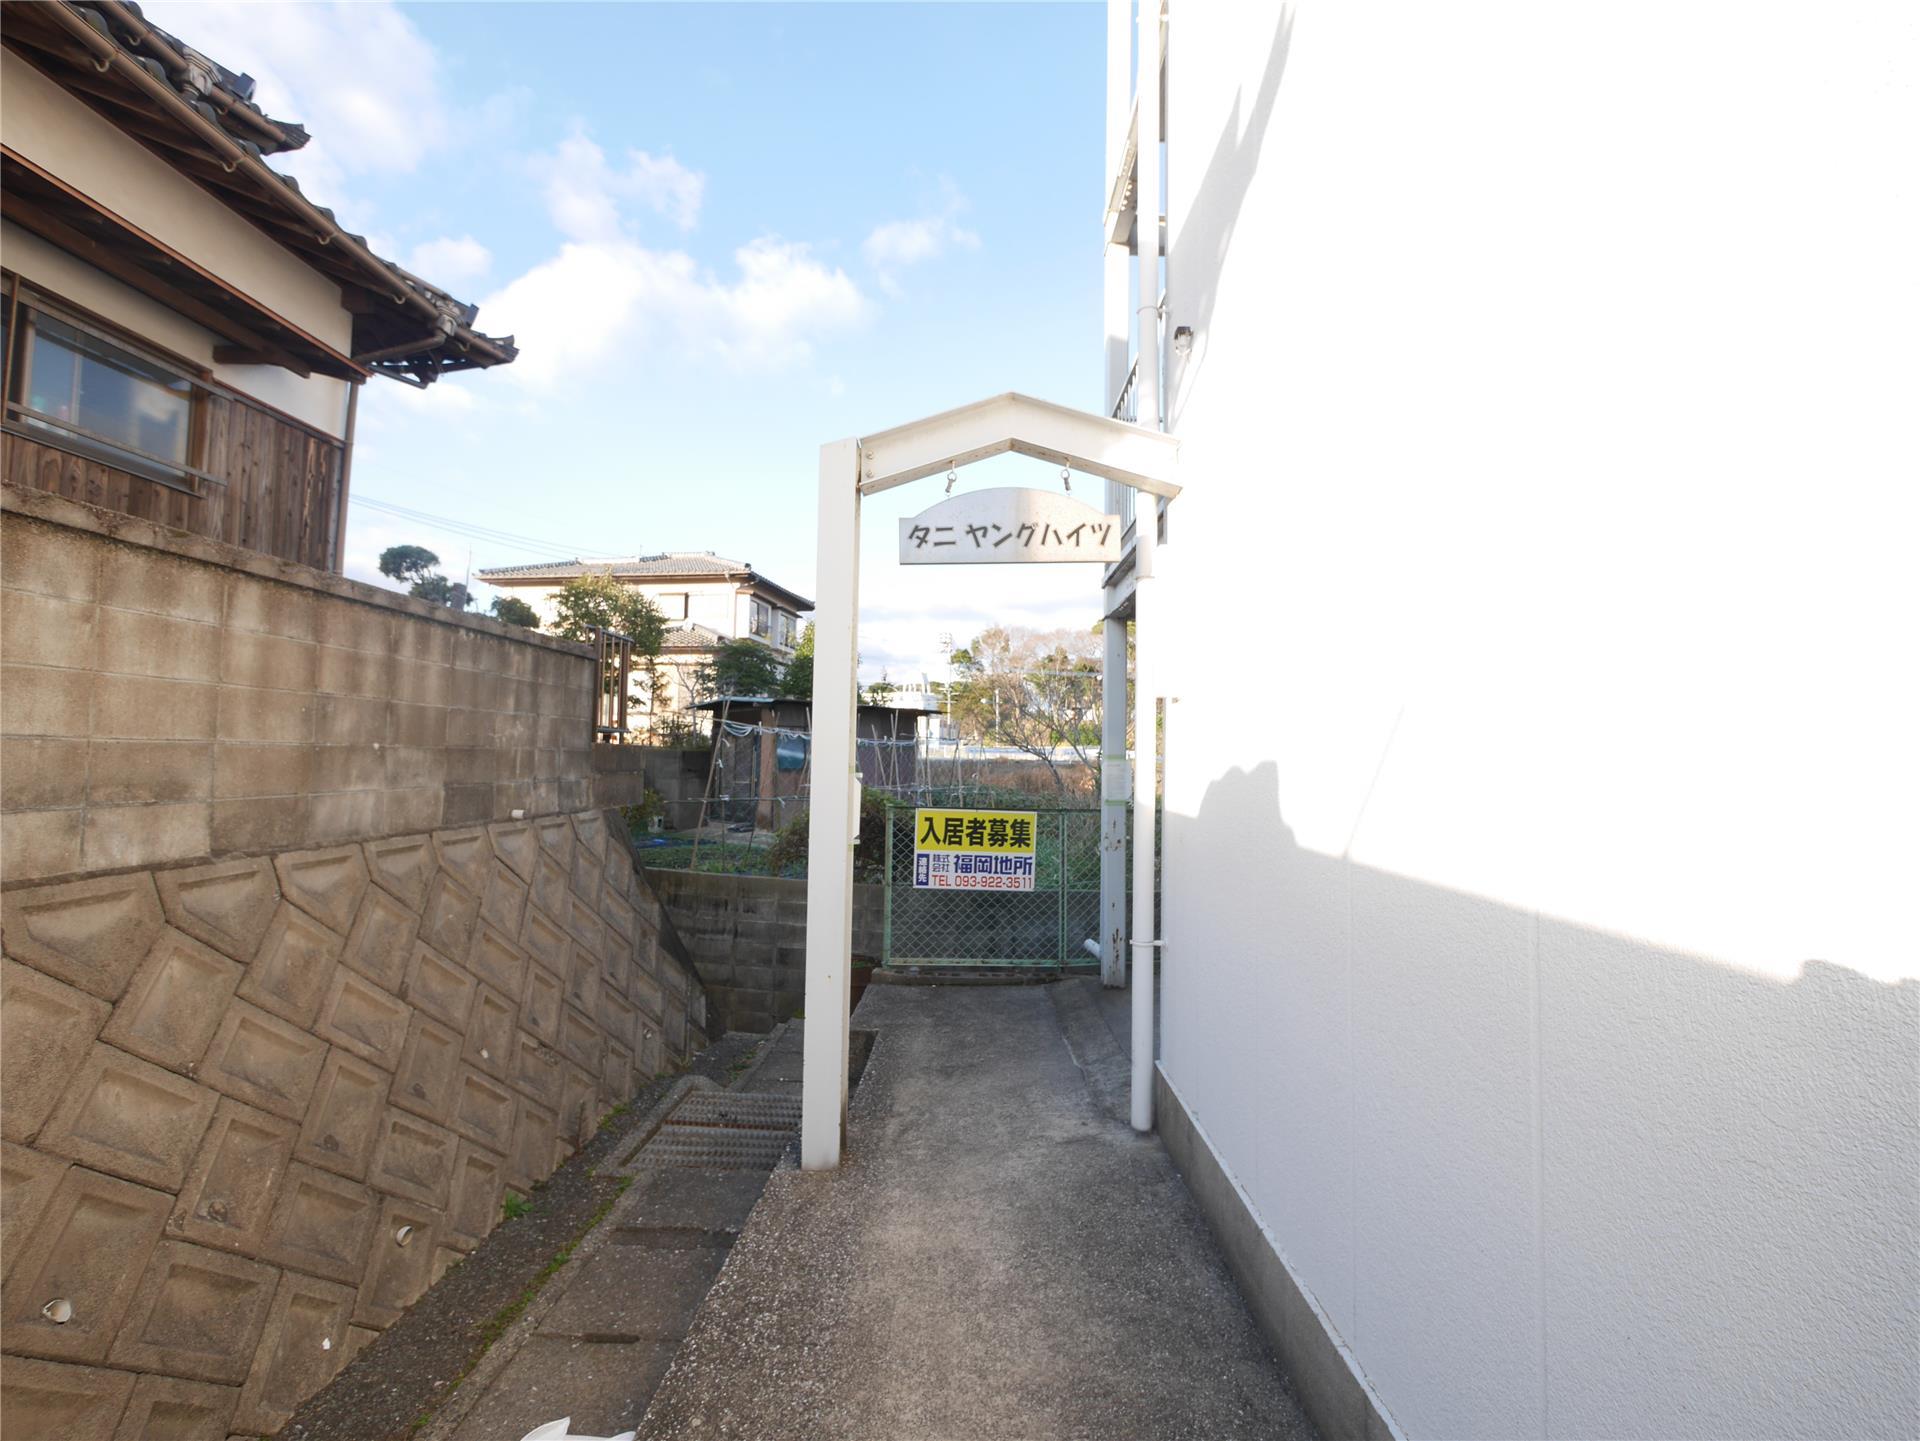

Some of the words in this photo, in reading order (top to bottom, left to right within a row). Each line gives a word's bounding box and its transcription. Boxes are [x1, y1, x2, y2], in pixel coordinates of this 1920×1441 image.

[920, 817, 1031, 848] 入居者募集
[954, 854, 1033, 876] 福岡地所
[932, 875, 951, 887] TEL
[955, 876, 1032, 889] 093-922-3511
